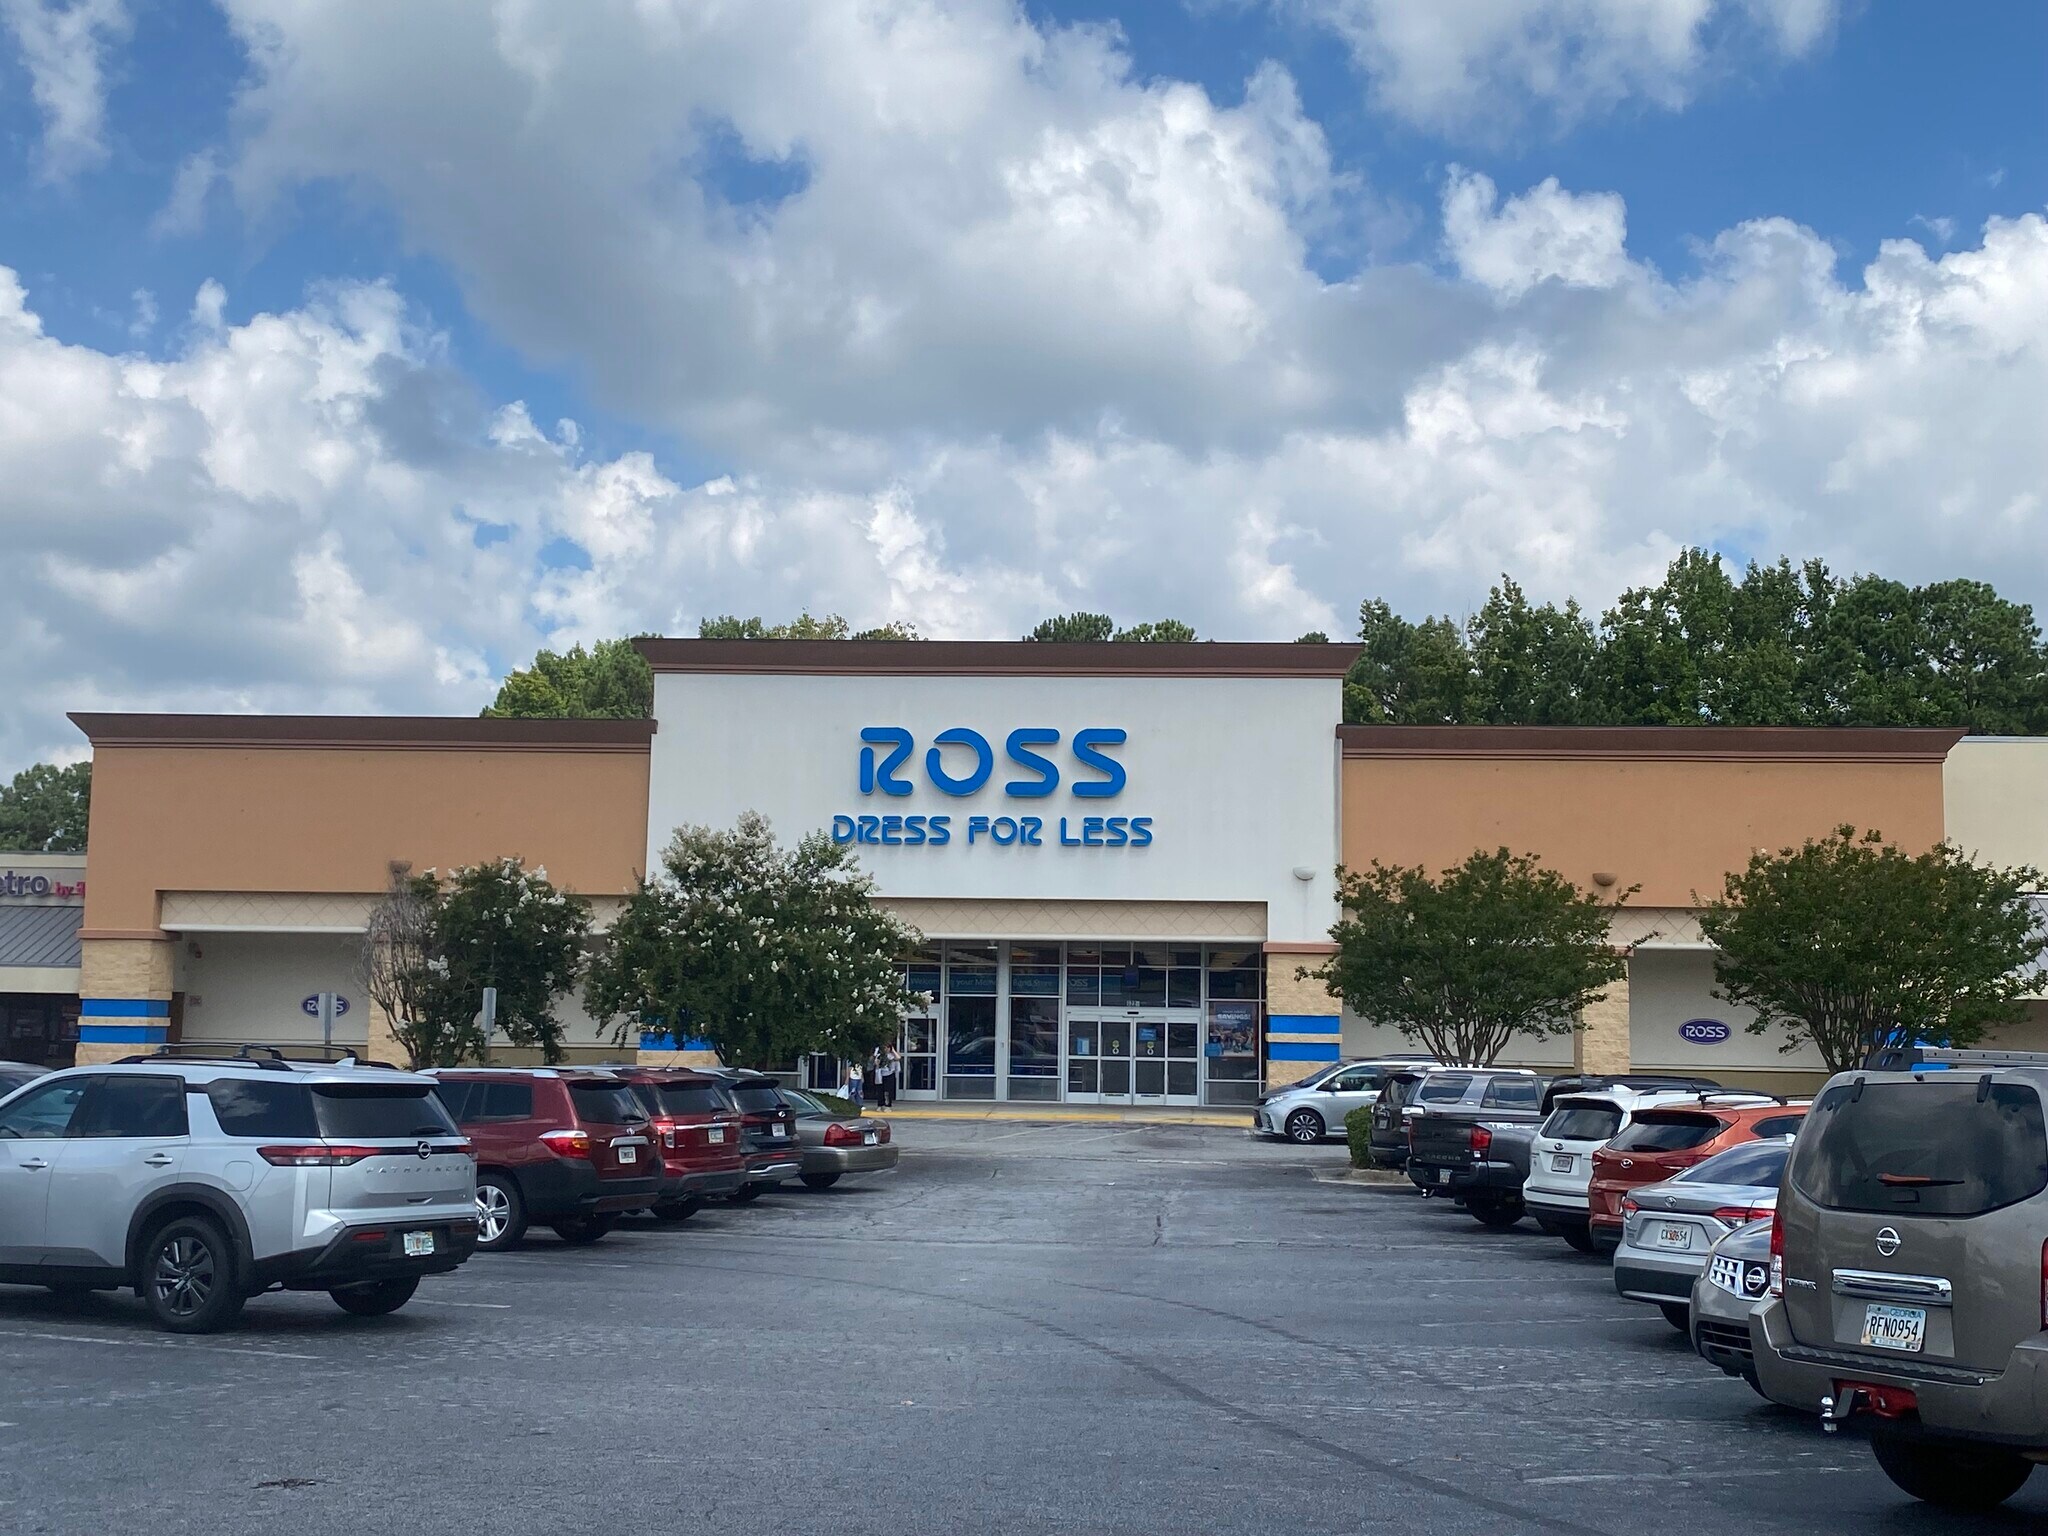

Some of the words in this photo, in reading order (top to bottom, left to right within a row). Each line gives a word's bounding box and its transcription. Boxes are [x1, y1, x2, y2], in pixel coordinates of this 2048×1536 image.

[860, 727, 1127, 797] ROSS
[833, 815, 951, 845] DRESS
[969, 816, 1042, 845] FOR
[1060, 817, 1153, 846] LESS
[1686, 1025, 1726, 1038] ROSS
[1488, 1122, 1513, 1130] TRD
[1890, 1308, 1922, 1319] GEORGIA
[1869, 1315, 1919, 1342] RFN0954
